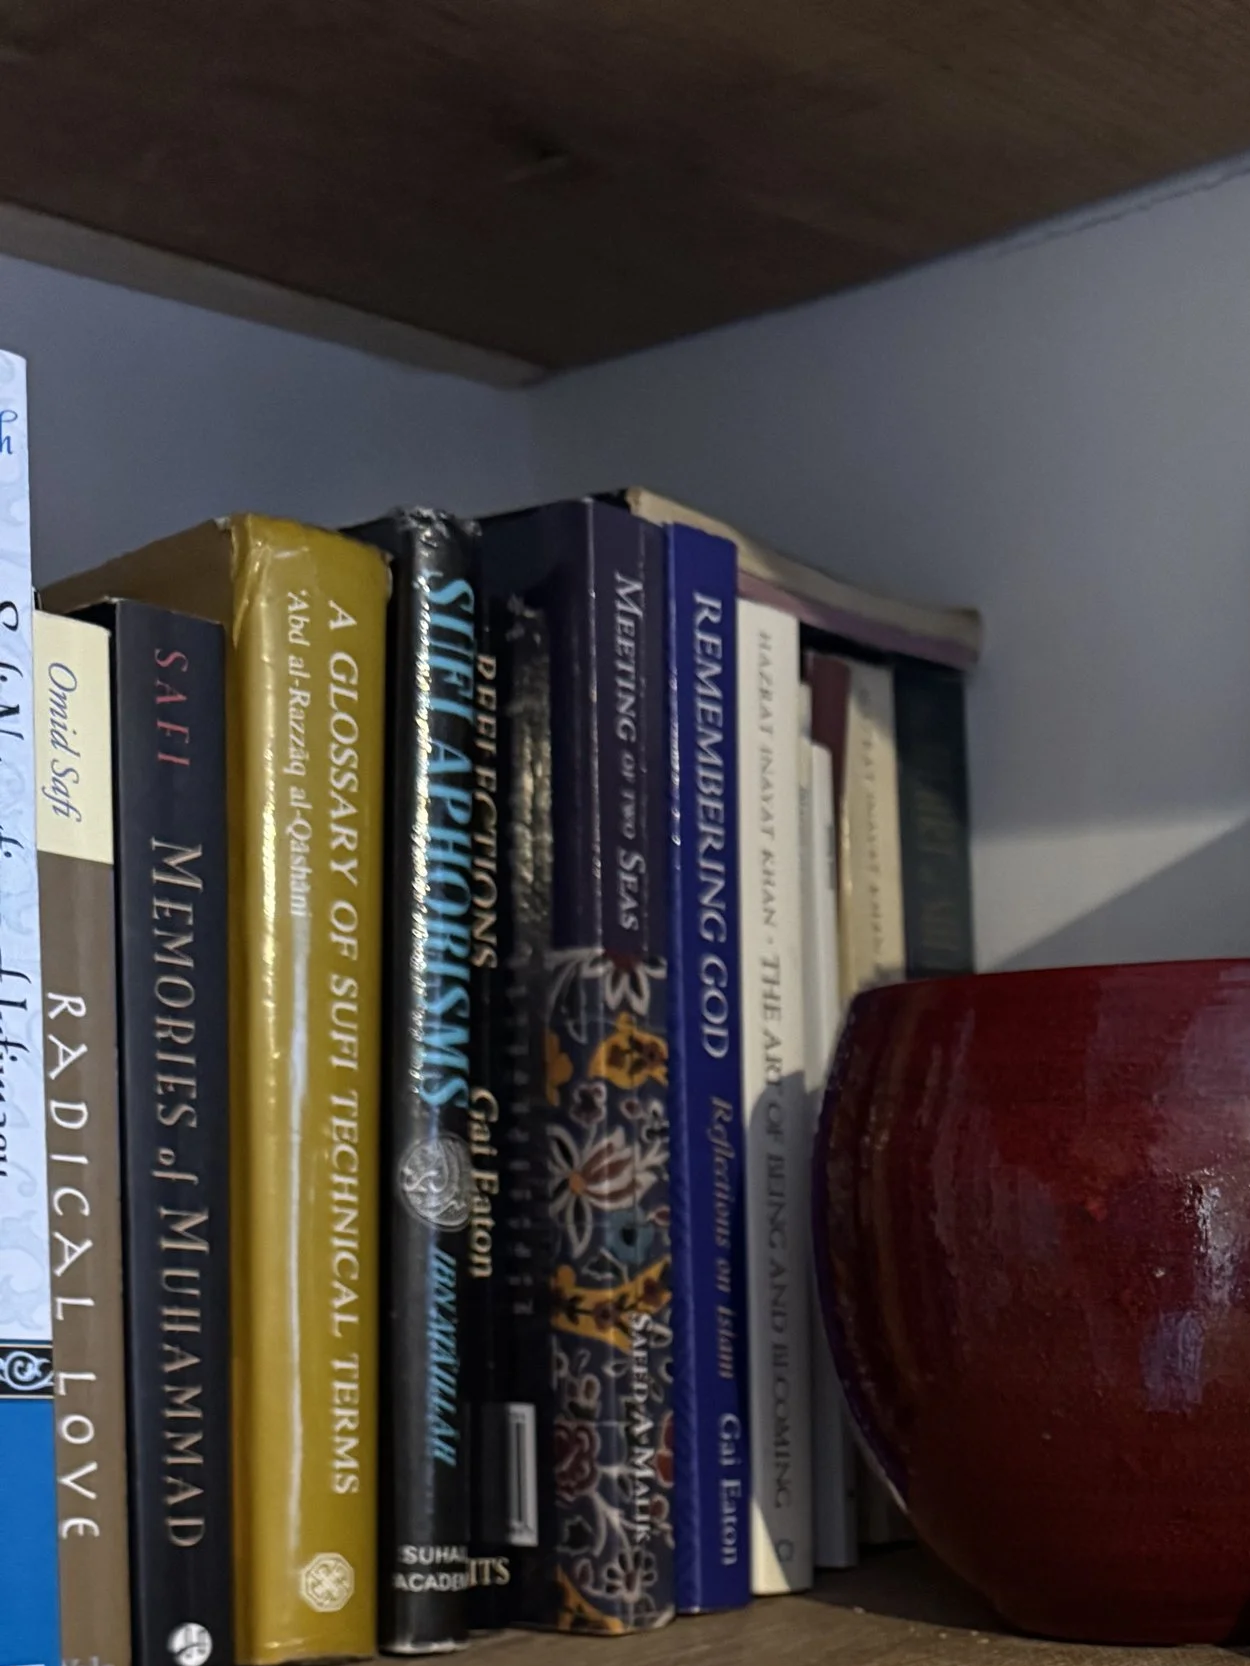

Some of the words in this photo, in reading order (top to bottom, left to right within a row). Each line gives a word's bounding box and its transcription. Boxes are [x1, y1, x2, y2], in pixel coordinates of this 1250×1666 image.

[329, 600, 358, 631] A
[613, 573, 645, 744] MEETING
[48, 661, 81, 755] Omid
[154, 648, 190, 766] SAFI
[41, 751, 83, 823] Safi
[327, 654, 359, 887] GLOSSARY
[693, 592, 728, 943] REMEMBERING
[329, 900, 359, 961] OF
[418, 740, 474, 1108] APHORISMS
[616, 848, 646, 930] SEAS
[152, 836, 203, 1128] MEMORIES
[328, 975, 359, 1071] SUFI
[700, 953, 730, 1058] GOD
[762, 957, 782, 1021] THE
[47, 991, 95, 1321] RADICAL
[151, 1148, 199, 1186] of
[470, 1087, 501, 1158] Gai
[766, 1104, 787, 1142] OF
[327, 1090, 360, 1338] TECHNICAL
[706, 1095, 735, 1248] Reflections
[766, 1154, 789, 1249] BEING
[467, 1168, 501, 1278] Eaton
[714, 1258, 732, 1292] on
[769, 1258, 790, 1335] AND
[157, 1205, 209, 1547] MUHAMMAD
[716, 1305, 740, 1379] Islam
[55, 1370, 101, 1538] LOVE
[329, 1353, 360, 1495] TERMS
[717, 1412, 741, 1467] Gai
[720, 1478, 744, 1566] Eaton
